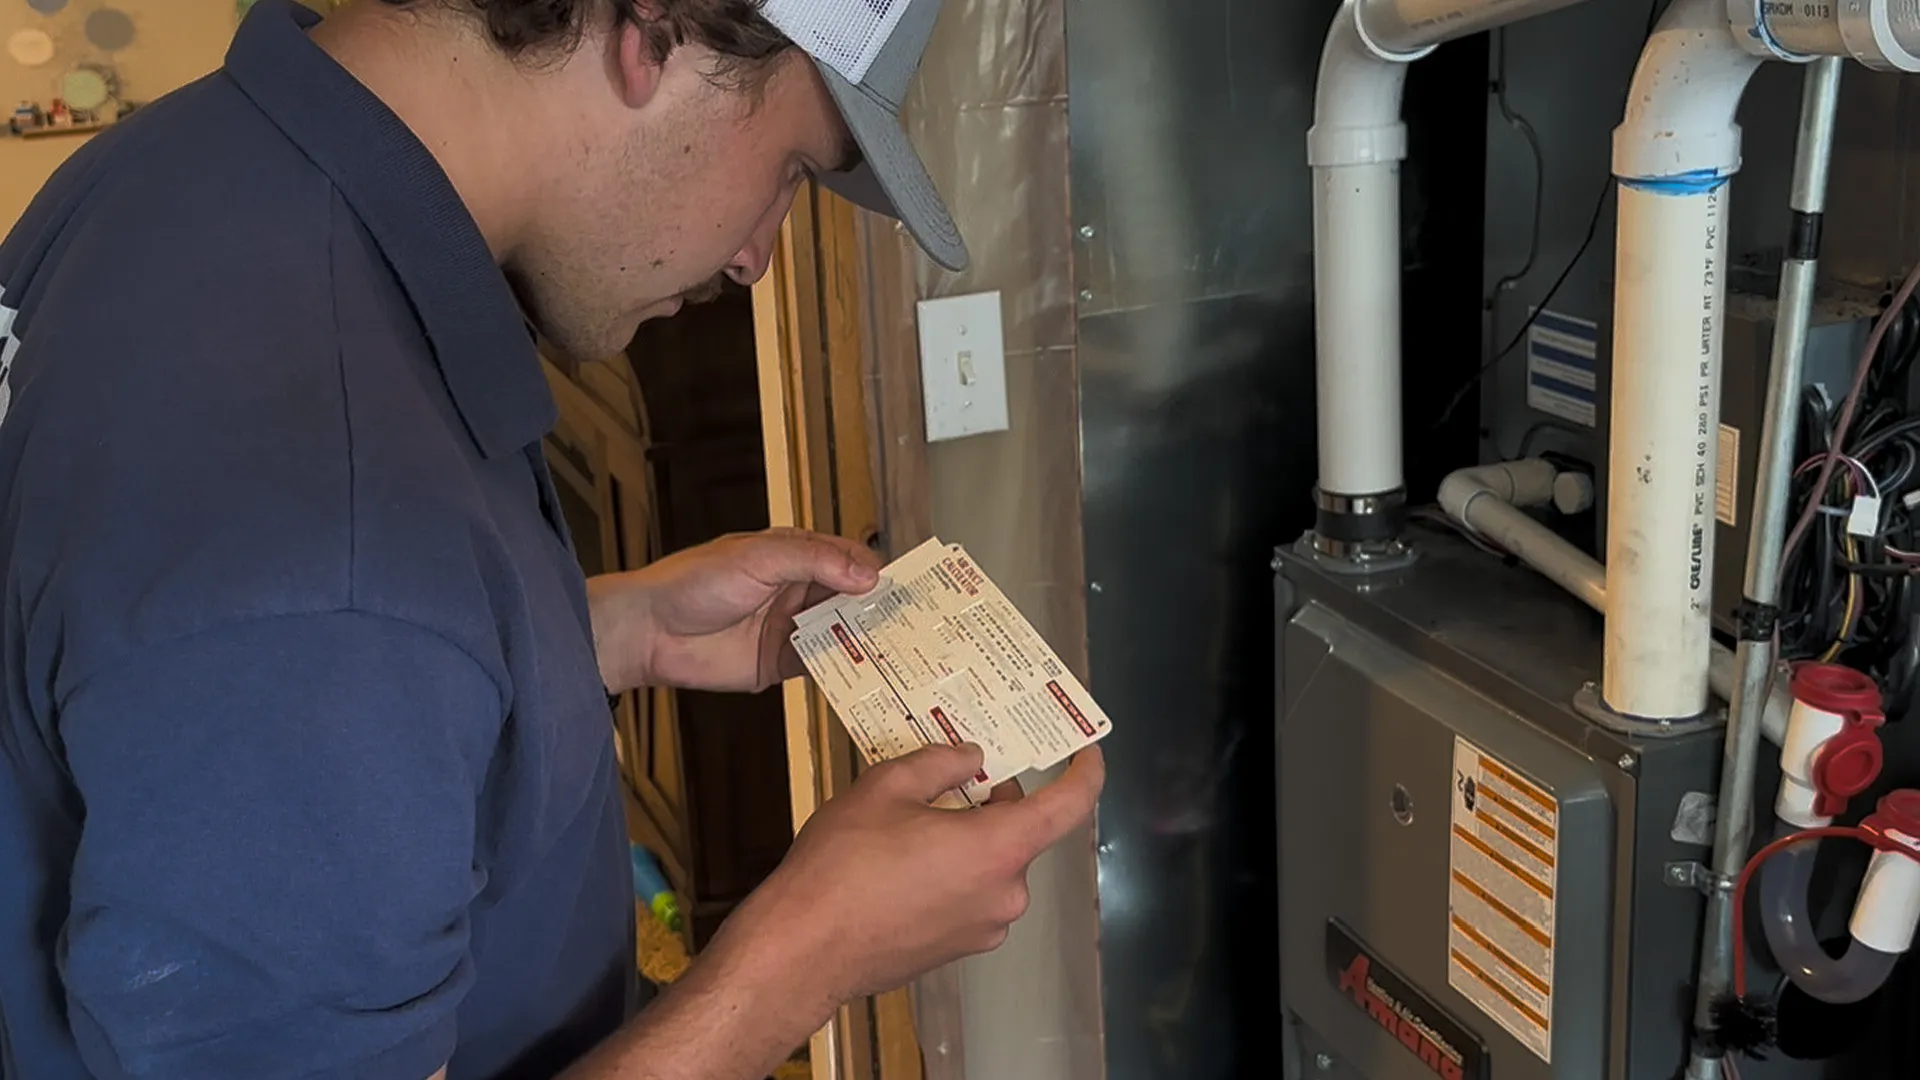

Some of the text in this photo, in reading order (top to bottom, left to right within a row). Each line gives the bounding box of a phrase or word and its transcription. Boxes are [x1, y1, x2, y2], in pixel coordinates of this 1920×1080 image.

[1804, 6, 1830, 18] 0113
[1705, 225, 1716, 250] PVC
[1703, 295, 1712, 310] AT
[1701, 316, 1711, 355] WATER
[1700, 361, 1709, 377] PR
[1699, 385, 1709, 406] PSI
[1698, 412, 1708, 435] 280
[1697, 442, 1706, 457] 40
[1695, 462, 1705, 486] SCH
[1694, 492, 1705, 515] PVC
[1338, 952, 1464, 1080] Amana
